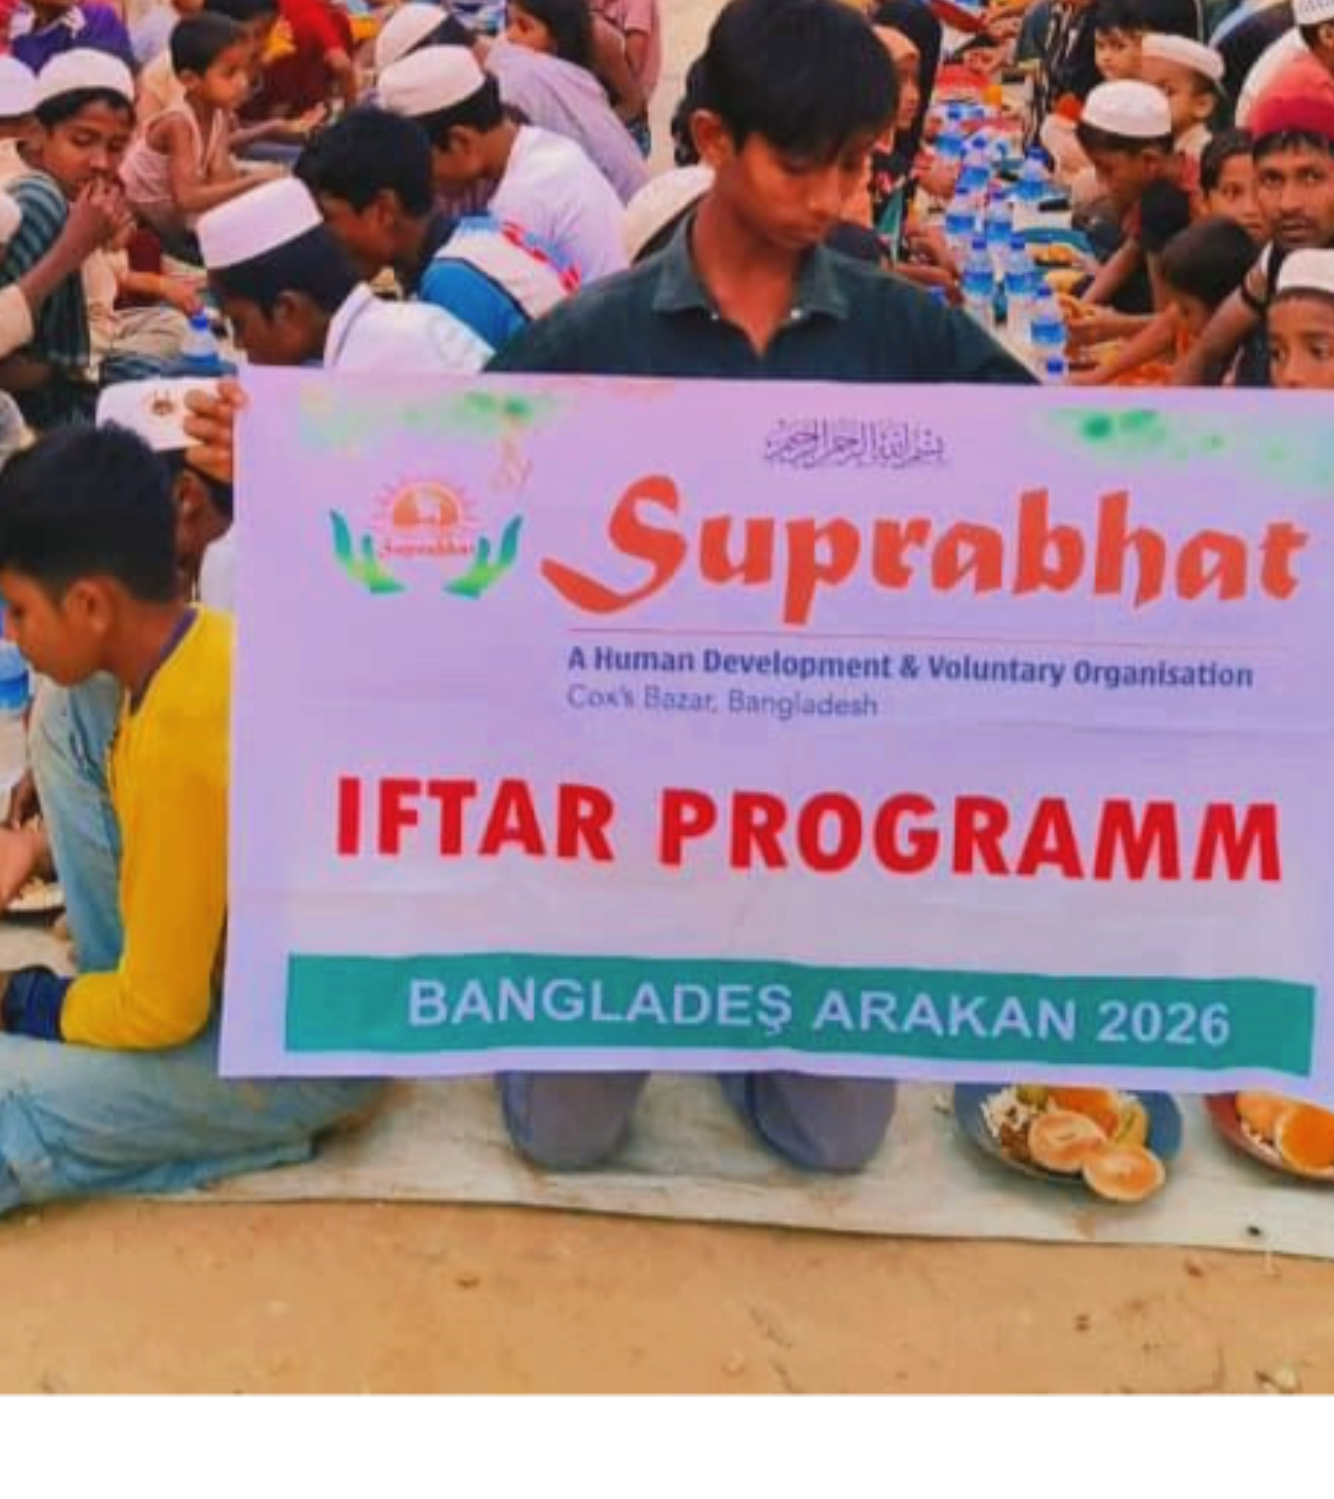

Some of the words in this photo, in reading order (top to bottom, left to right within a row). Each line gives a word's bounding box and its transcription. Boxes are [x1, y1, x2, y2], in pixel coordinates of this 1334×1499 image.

[540, 474, 1306, 627] Suprabhat
[568, 646, 586, 670] A
[593, 646, 695, 672] Human
[702, 649, 892, 680] Development
[898, 654, 921, 679] &
[928, 655, 1067, 688] Voluntary
[1073, 660, 1254, 689] Organisation
[727, 688, 879, 723] Bangladesh
[335, 773, 617, 867] IFTAR
[654, 786, 1284, 884] PROGRAMM
[408, 976, 793, 1035] BANGLADEŞ
[812, 989, 1076, 1042] ARAKAN
[1096, 1000, 1232, 1047] 2026
